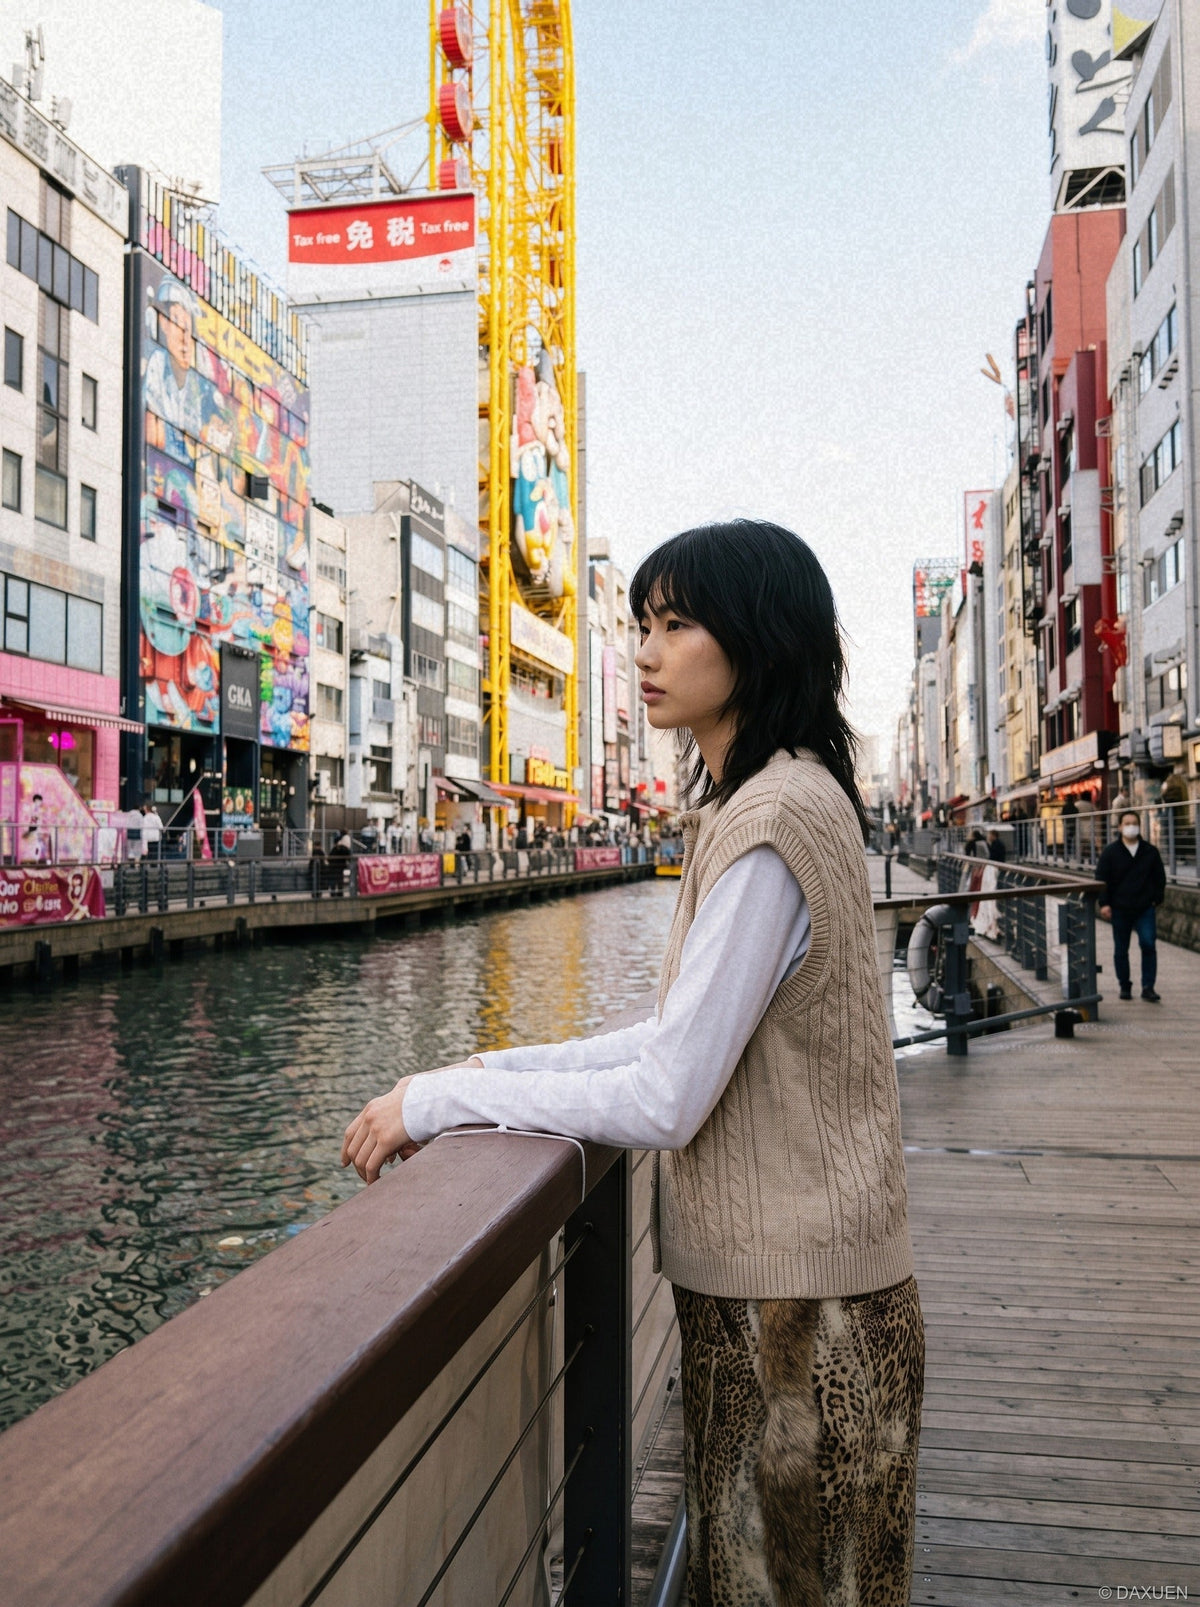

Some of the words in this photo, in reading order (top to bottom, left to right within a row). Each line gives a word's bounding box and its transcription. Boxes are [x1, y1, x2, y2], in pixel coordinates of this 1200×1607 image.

[293, 234, 314, 247] Tax
[316, 232, 341, 245] free
[420, 222, 441, 235] Tax
[443, 220, 470, 233] free
[227, 684, 253, 708] GKA
